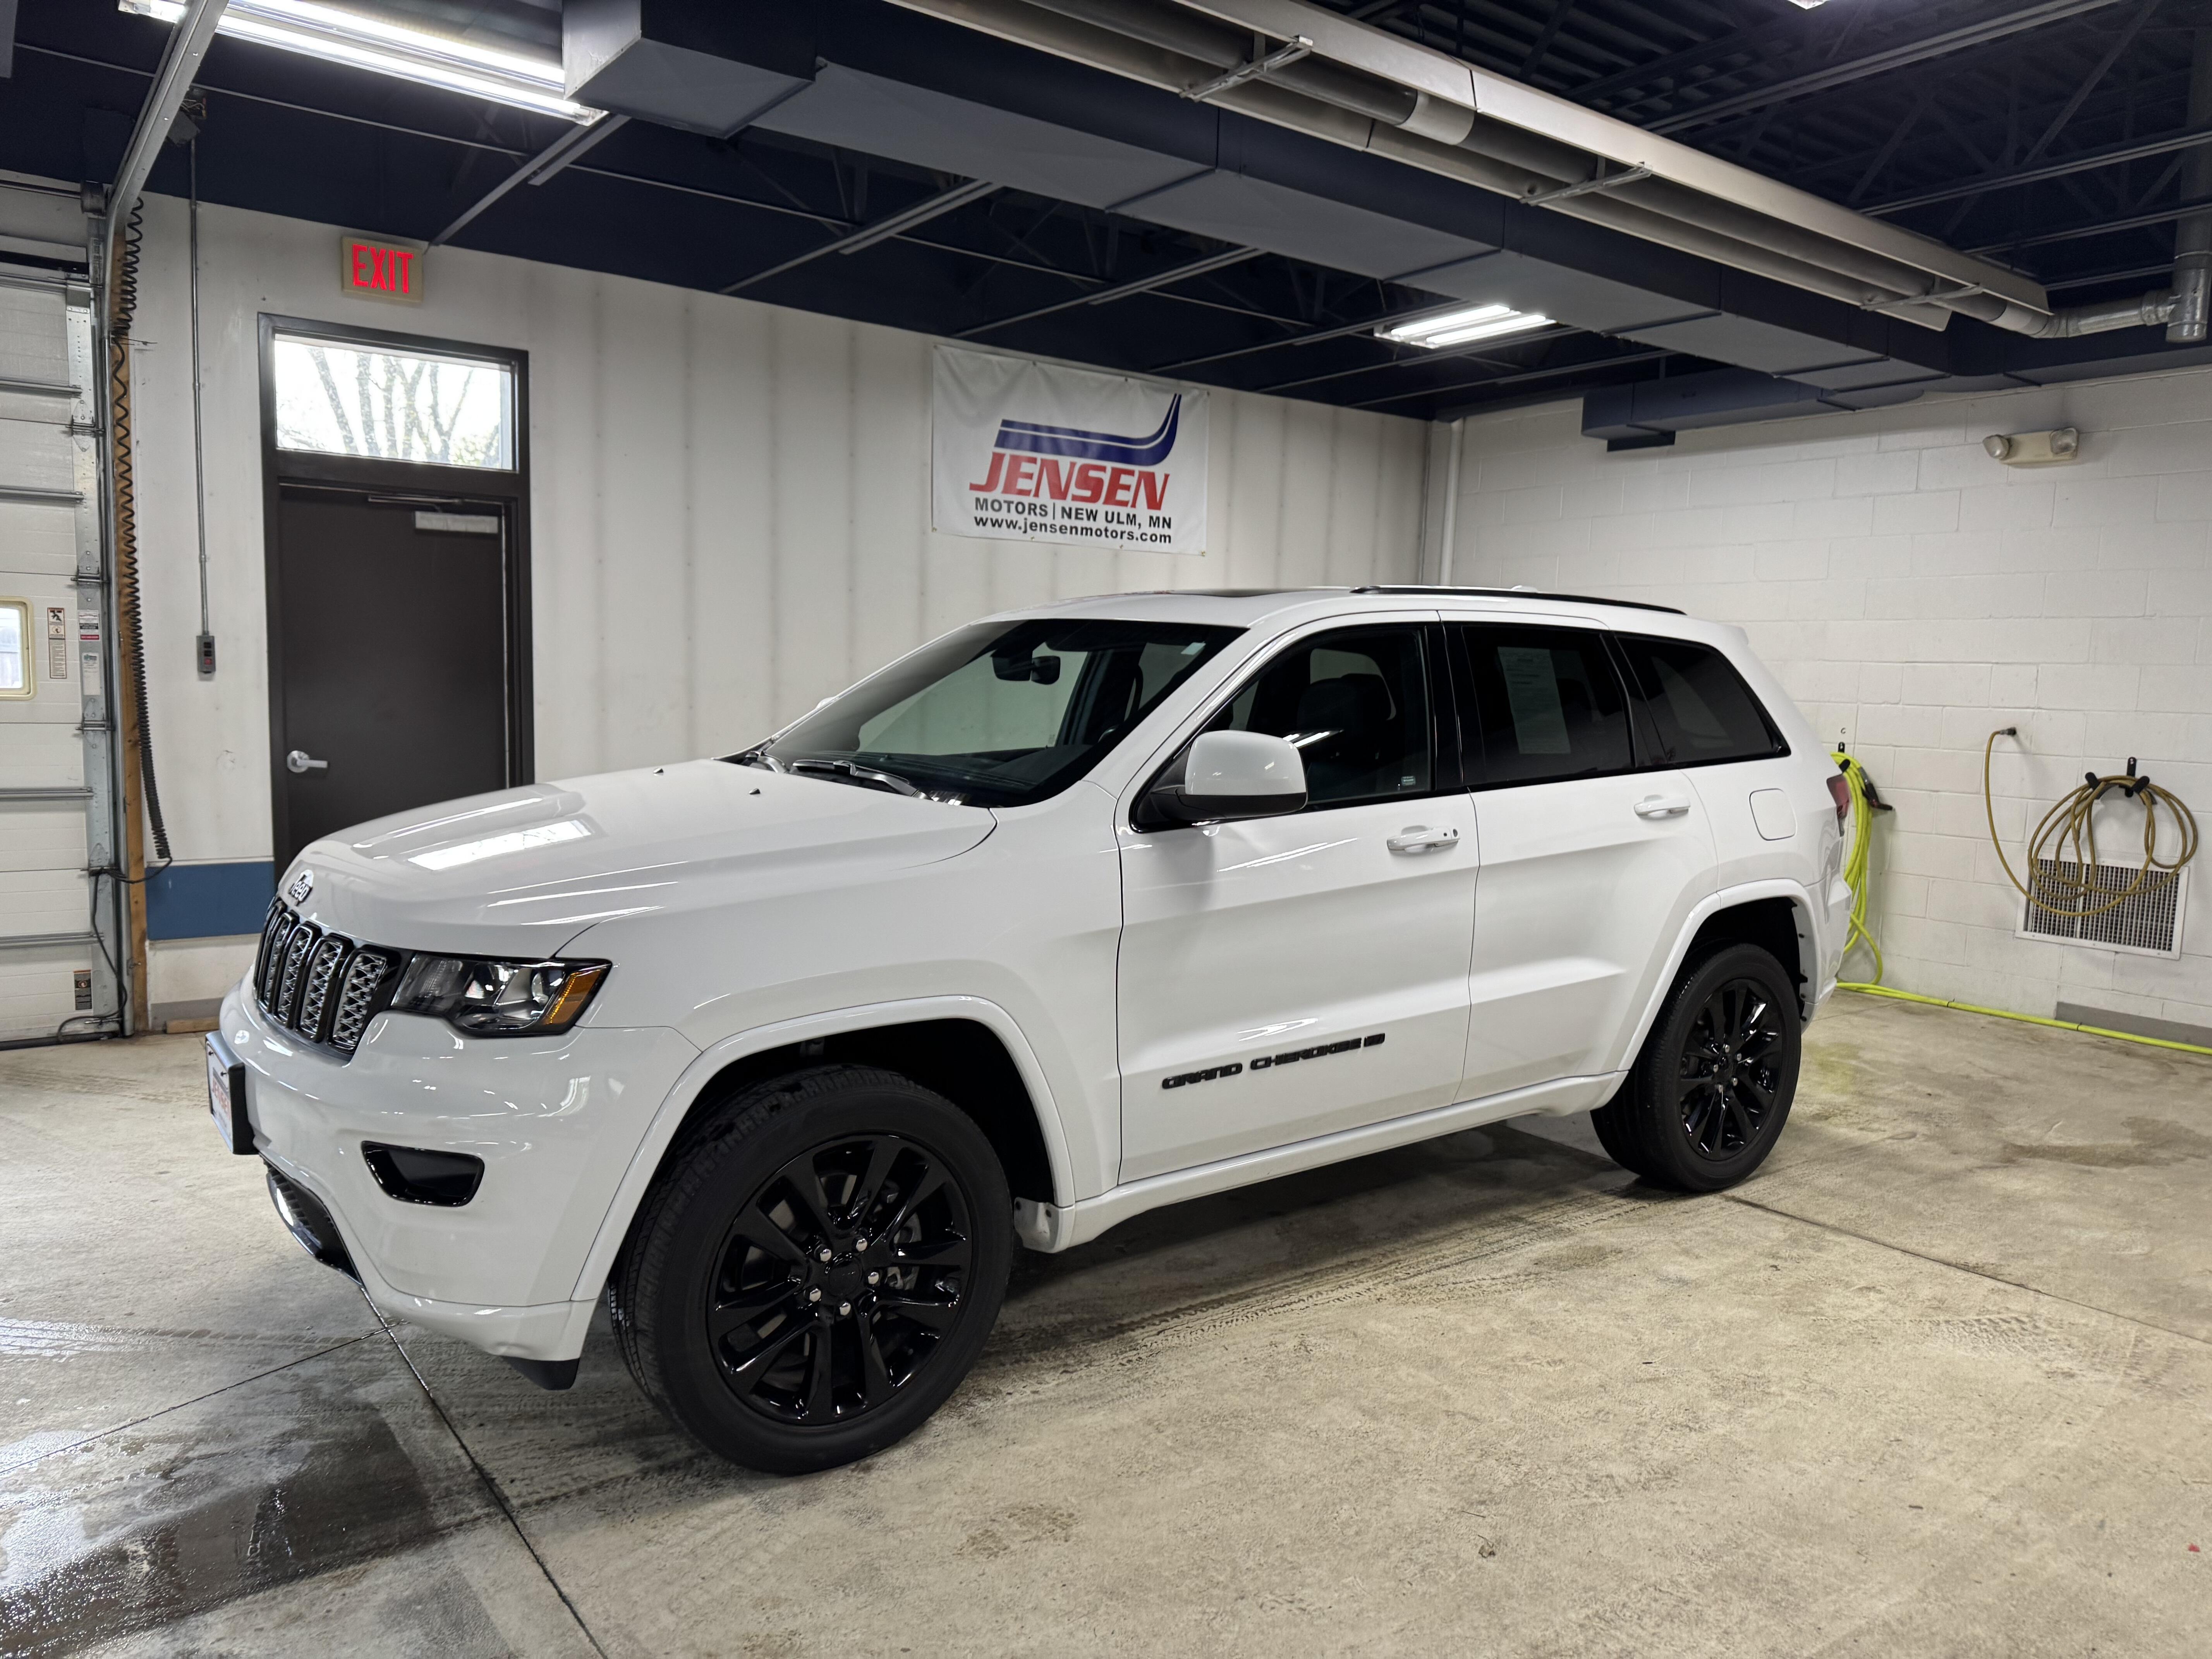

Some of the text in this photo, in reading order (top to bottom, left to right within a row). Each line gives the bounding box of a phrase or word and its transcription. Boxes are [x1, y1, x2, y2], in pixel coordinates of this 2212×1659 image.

[352, 244, 414, 294] EXIT
[969, 451, 1170, 511] JENSEN
[974, 516, 1171, 544] www.jensenmotors.com
[975, 497, 1171, 529] MOTORS NEW ULM, MN
[1162, 1037, 1362, 1089] GRAND CHEROKEE
